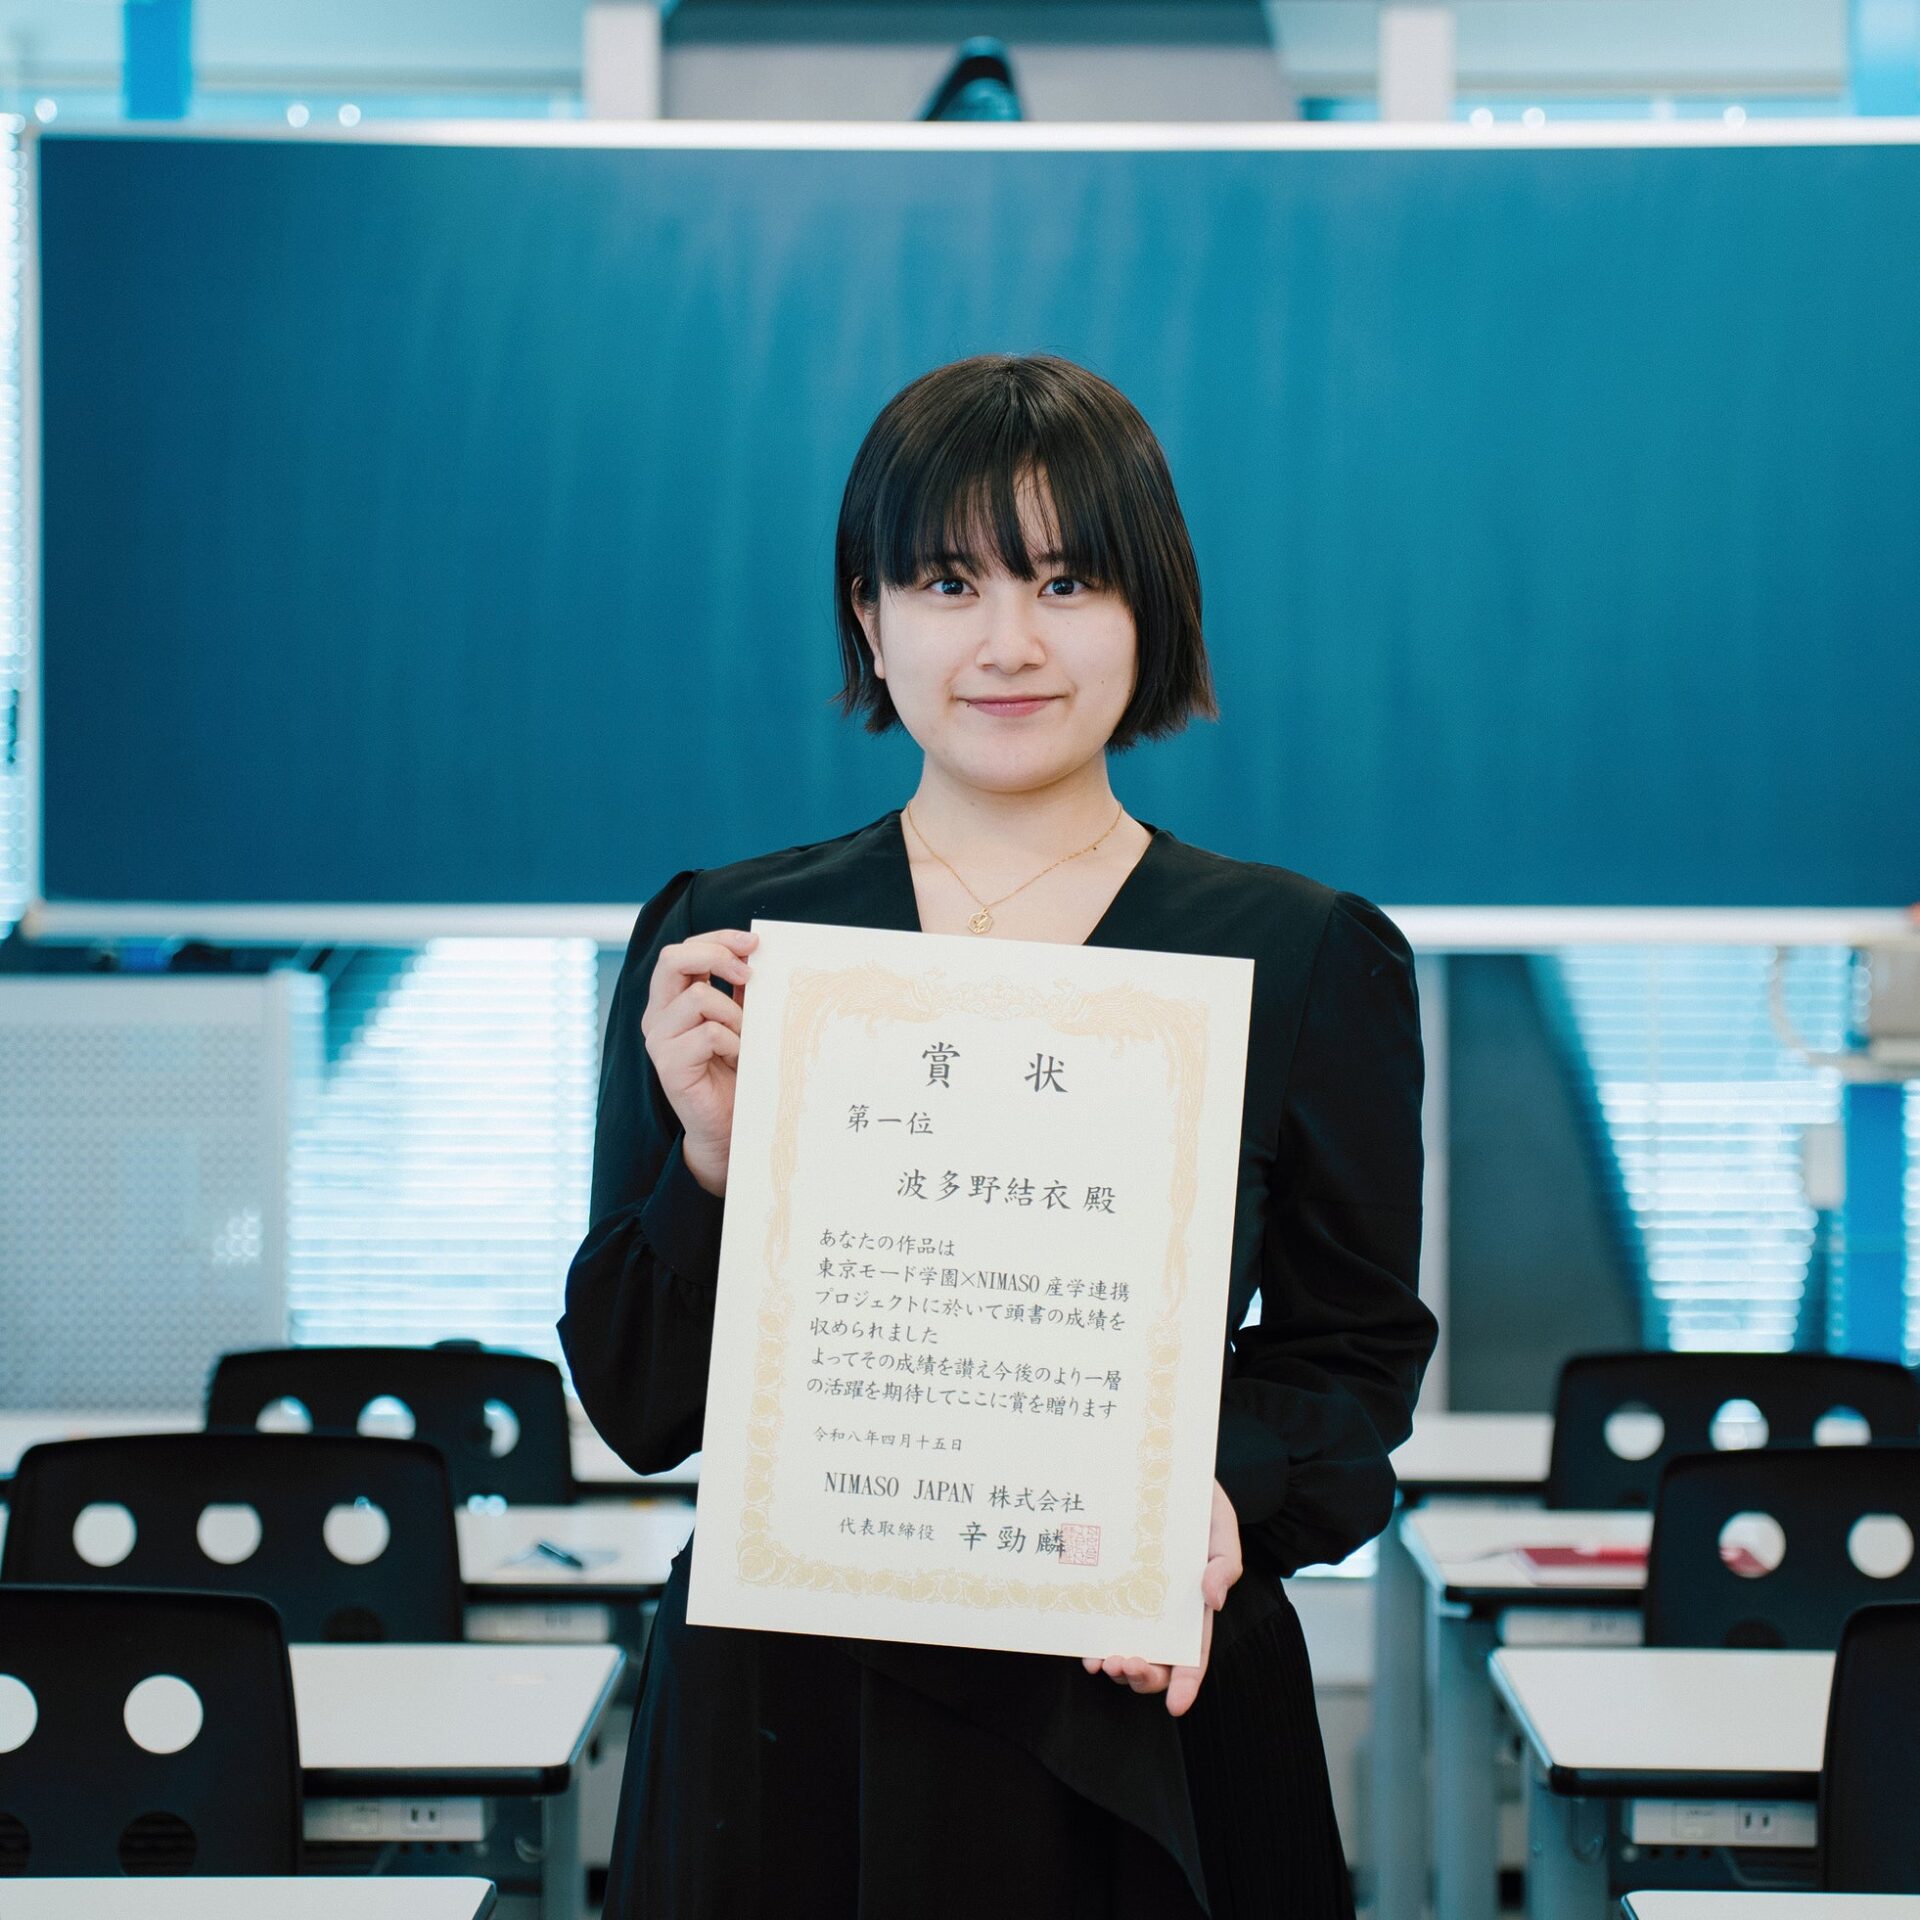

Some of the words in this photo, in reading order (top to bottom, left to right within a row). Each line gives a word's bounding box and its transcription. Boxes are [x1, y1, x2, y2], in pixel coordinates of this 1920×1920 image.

[847, 1104, 934, 1136] 第一位
[896, 1168, 1072, 1211] 波多野結衣
[819, 1228, 955, 1257] あなたの作品は
[814, 1287, 1126, 1332] プロジェクトに於いて頭書の成績を
[809, 1316, 938, 1345] 収められました
[806, 1377, 1117, 1419] の活躍を期待してここに賞を贈ります
[815, 1426, 962, 1452] 令和八年四月十五日
[824, 1471, 900, 1498] NIMASO
[912, 1479, 975, 1504] JAPAN
[988, 1484, 1085, 1514] 株式会社
[839, 1516, 934, 1541] 代表取締役
